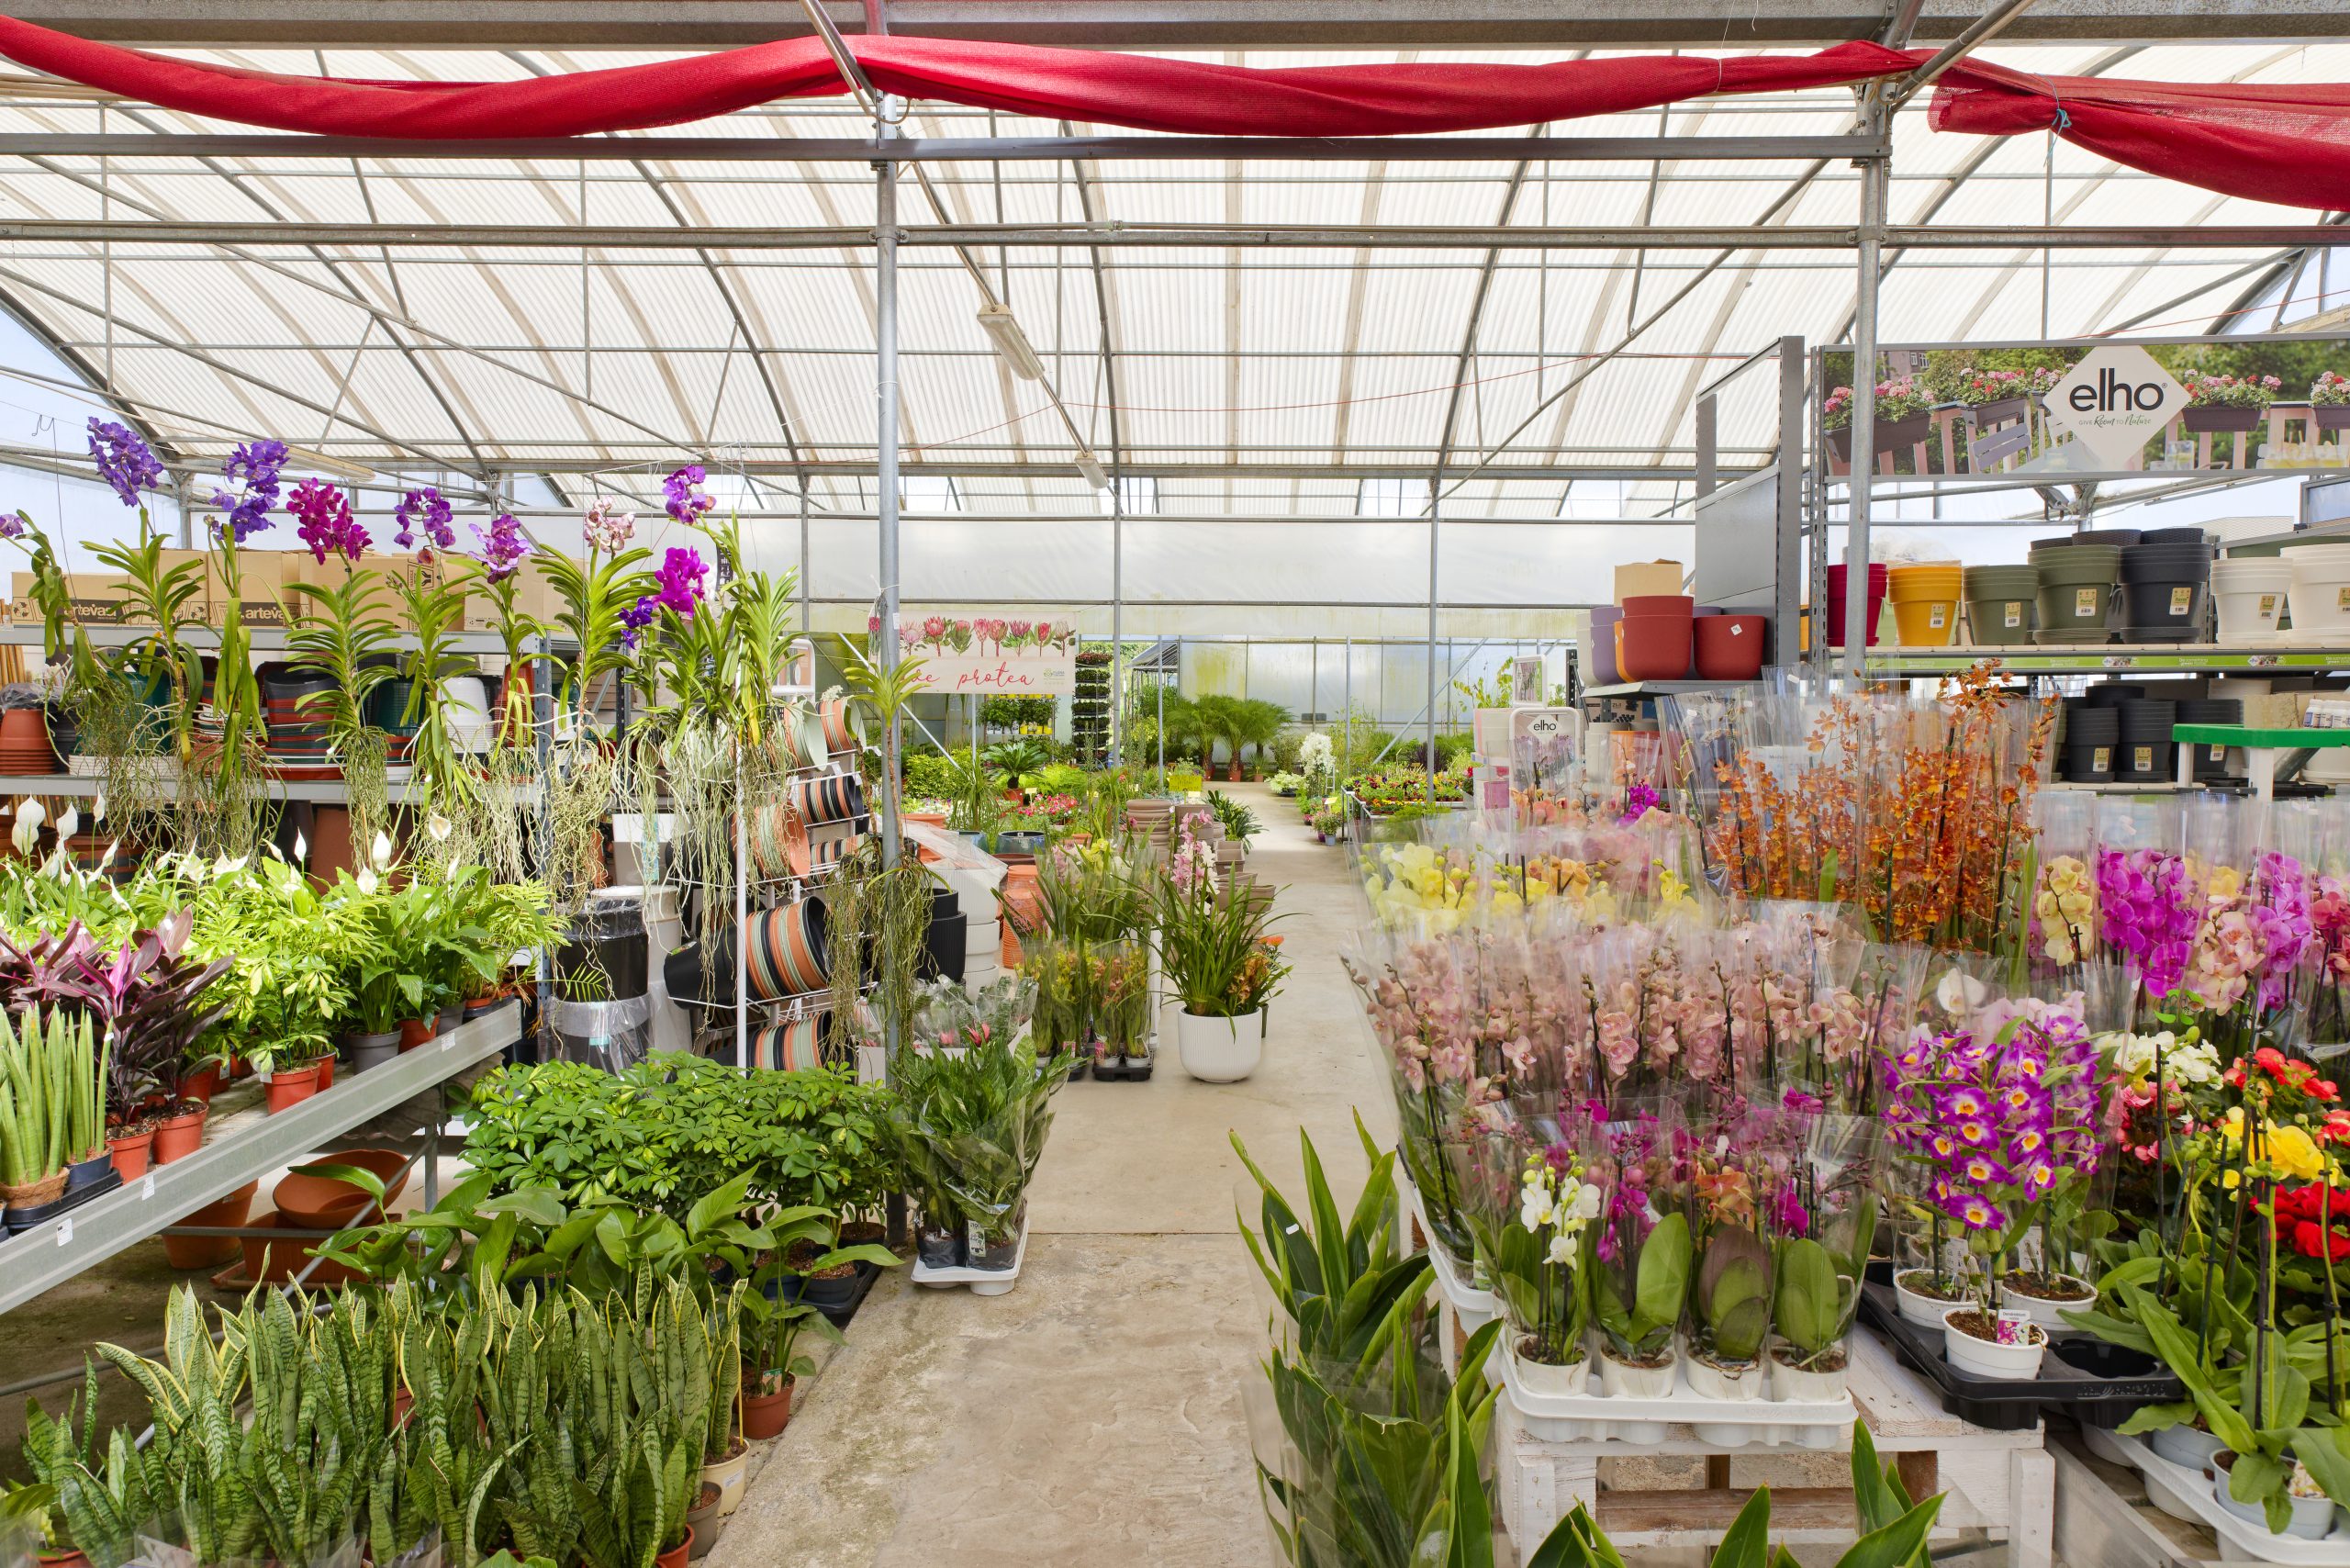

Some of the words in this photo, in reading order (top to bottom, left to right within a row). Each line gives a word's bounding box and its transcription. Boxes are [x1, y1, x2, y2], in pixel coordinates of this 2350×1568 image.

[2069, 367, 2165, 412] elho
[2094, 414, 2115, 428] Room
[2124, 413, 2153, 426] Nature
[957, 661, 1035, 690] protea
[1533, 719, 1557, 732] elho
